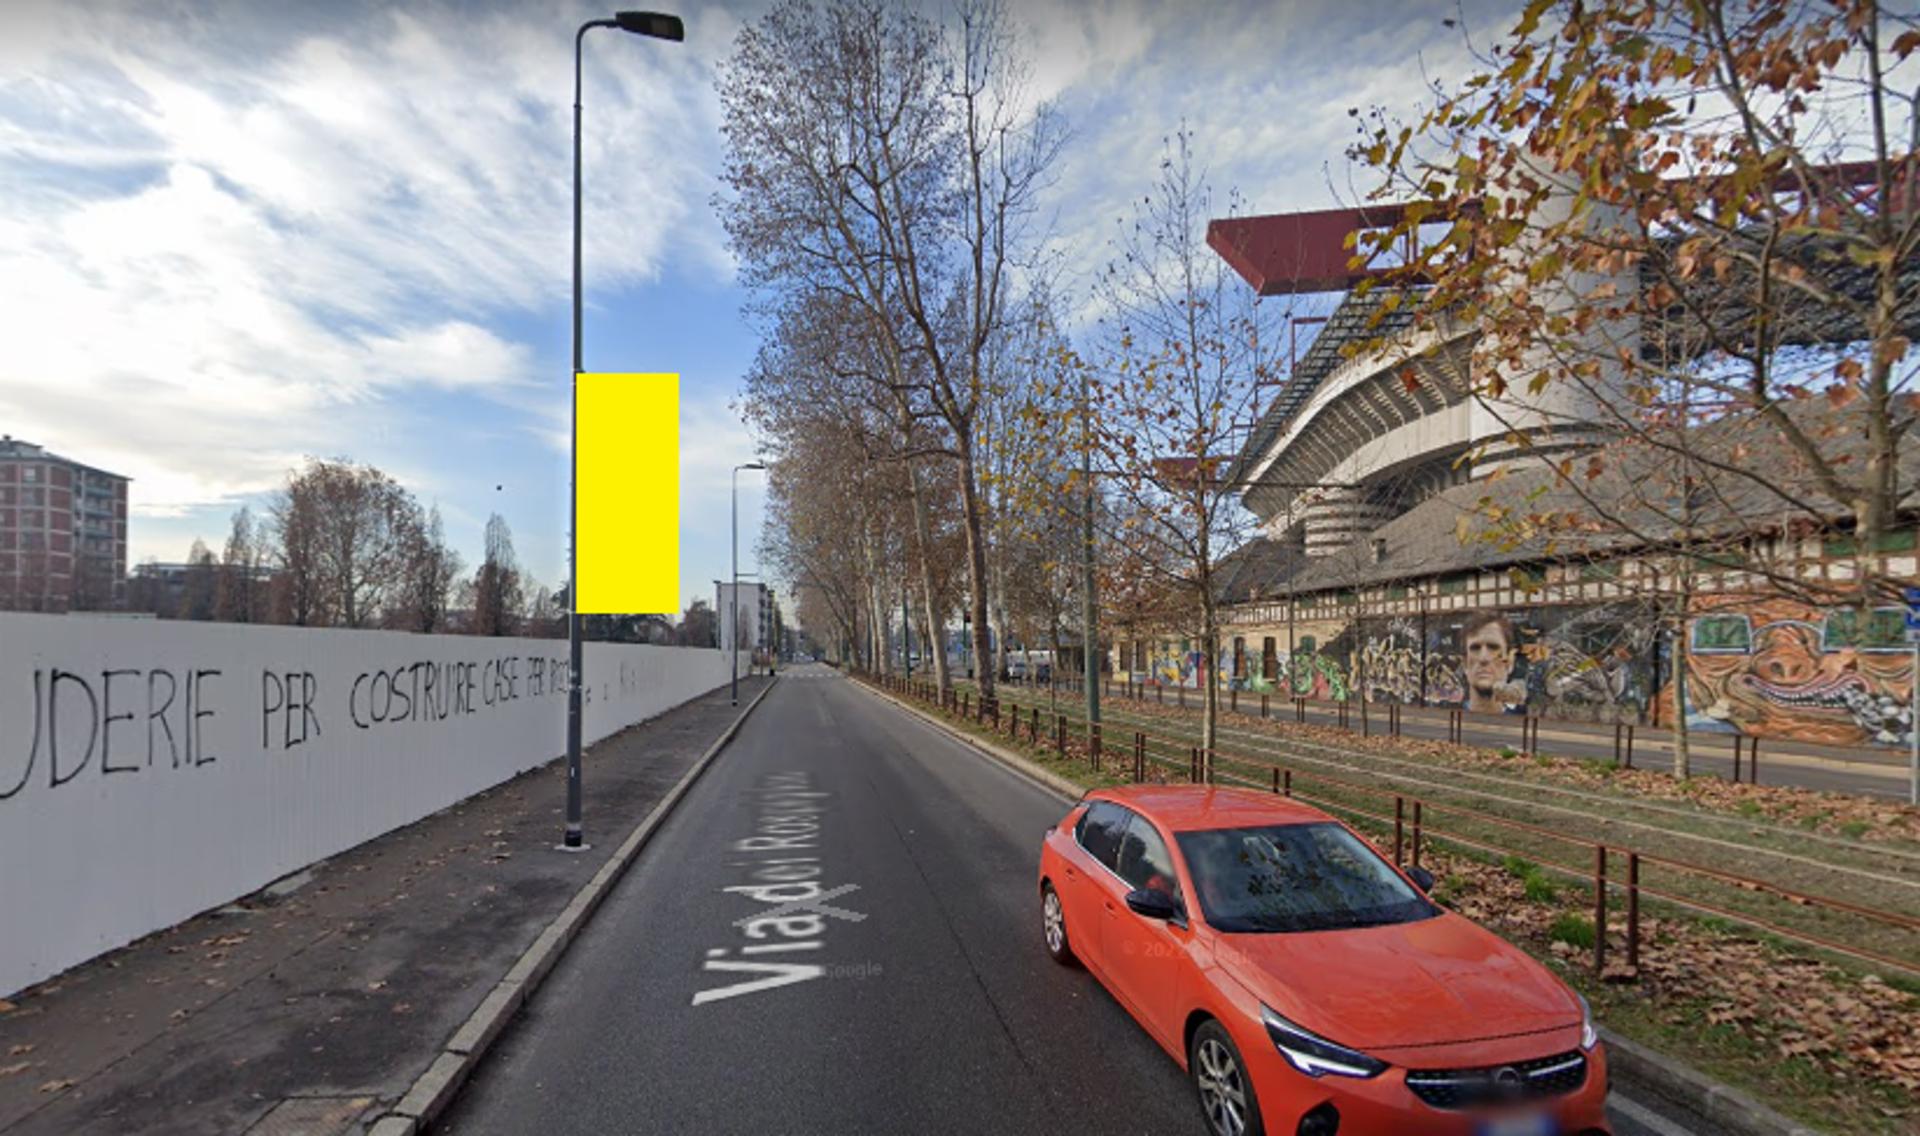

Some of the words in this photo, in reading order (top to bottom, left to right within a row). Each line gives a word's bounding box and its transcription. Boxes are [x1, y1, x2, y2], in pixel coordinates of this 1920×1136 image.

[263, 668, 321, 749] PER
[350, 661, 476, 729] COSTRUIRE
[483, 657, 519, 705] CASE
